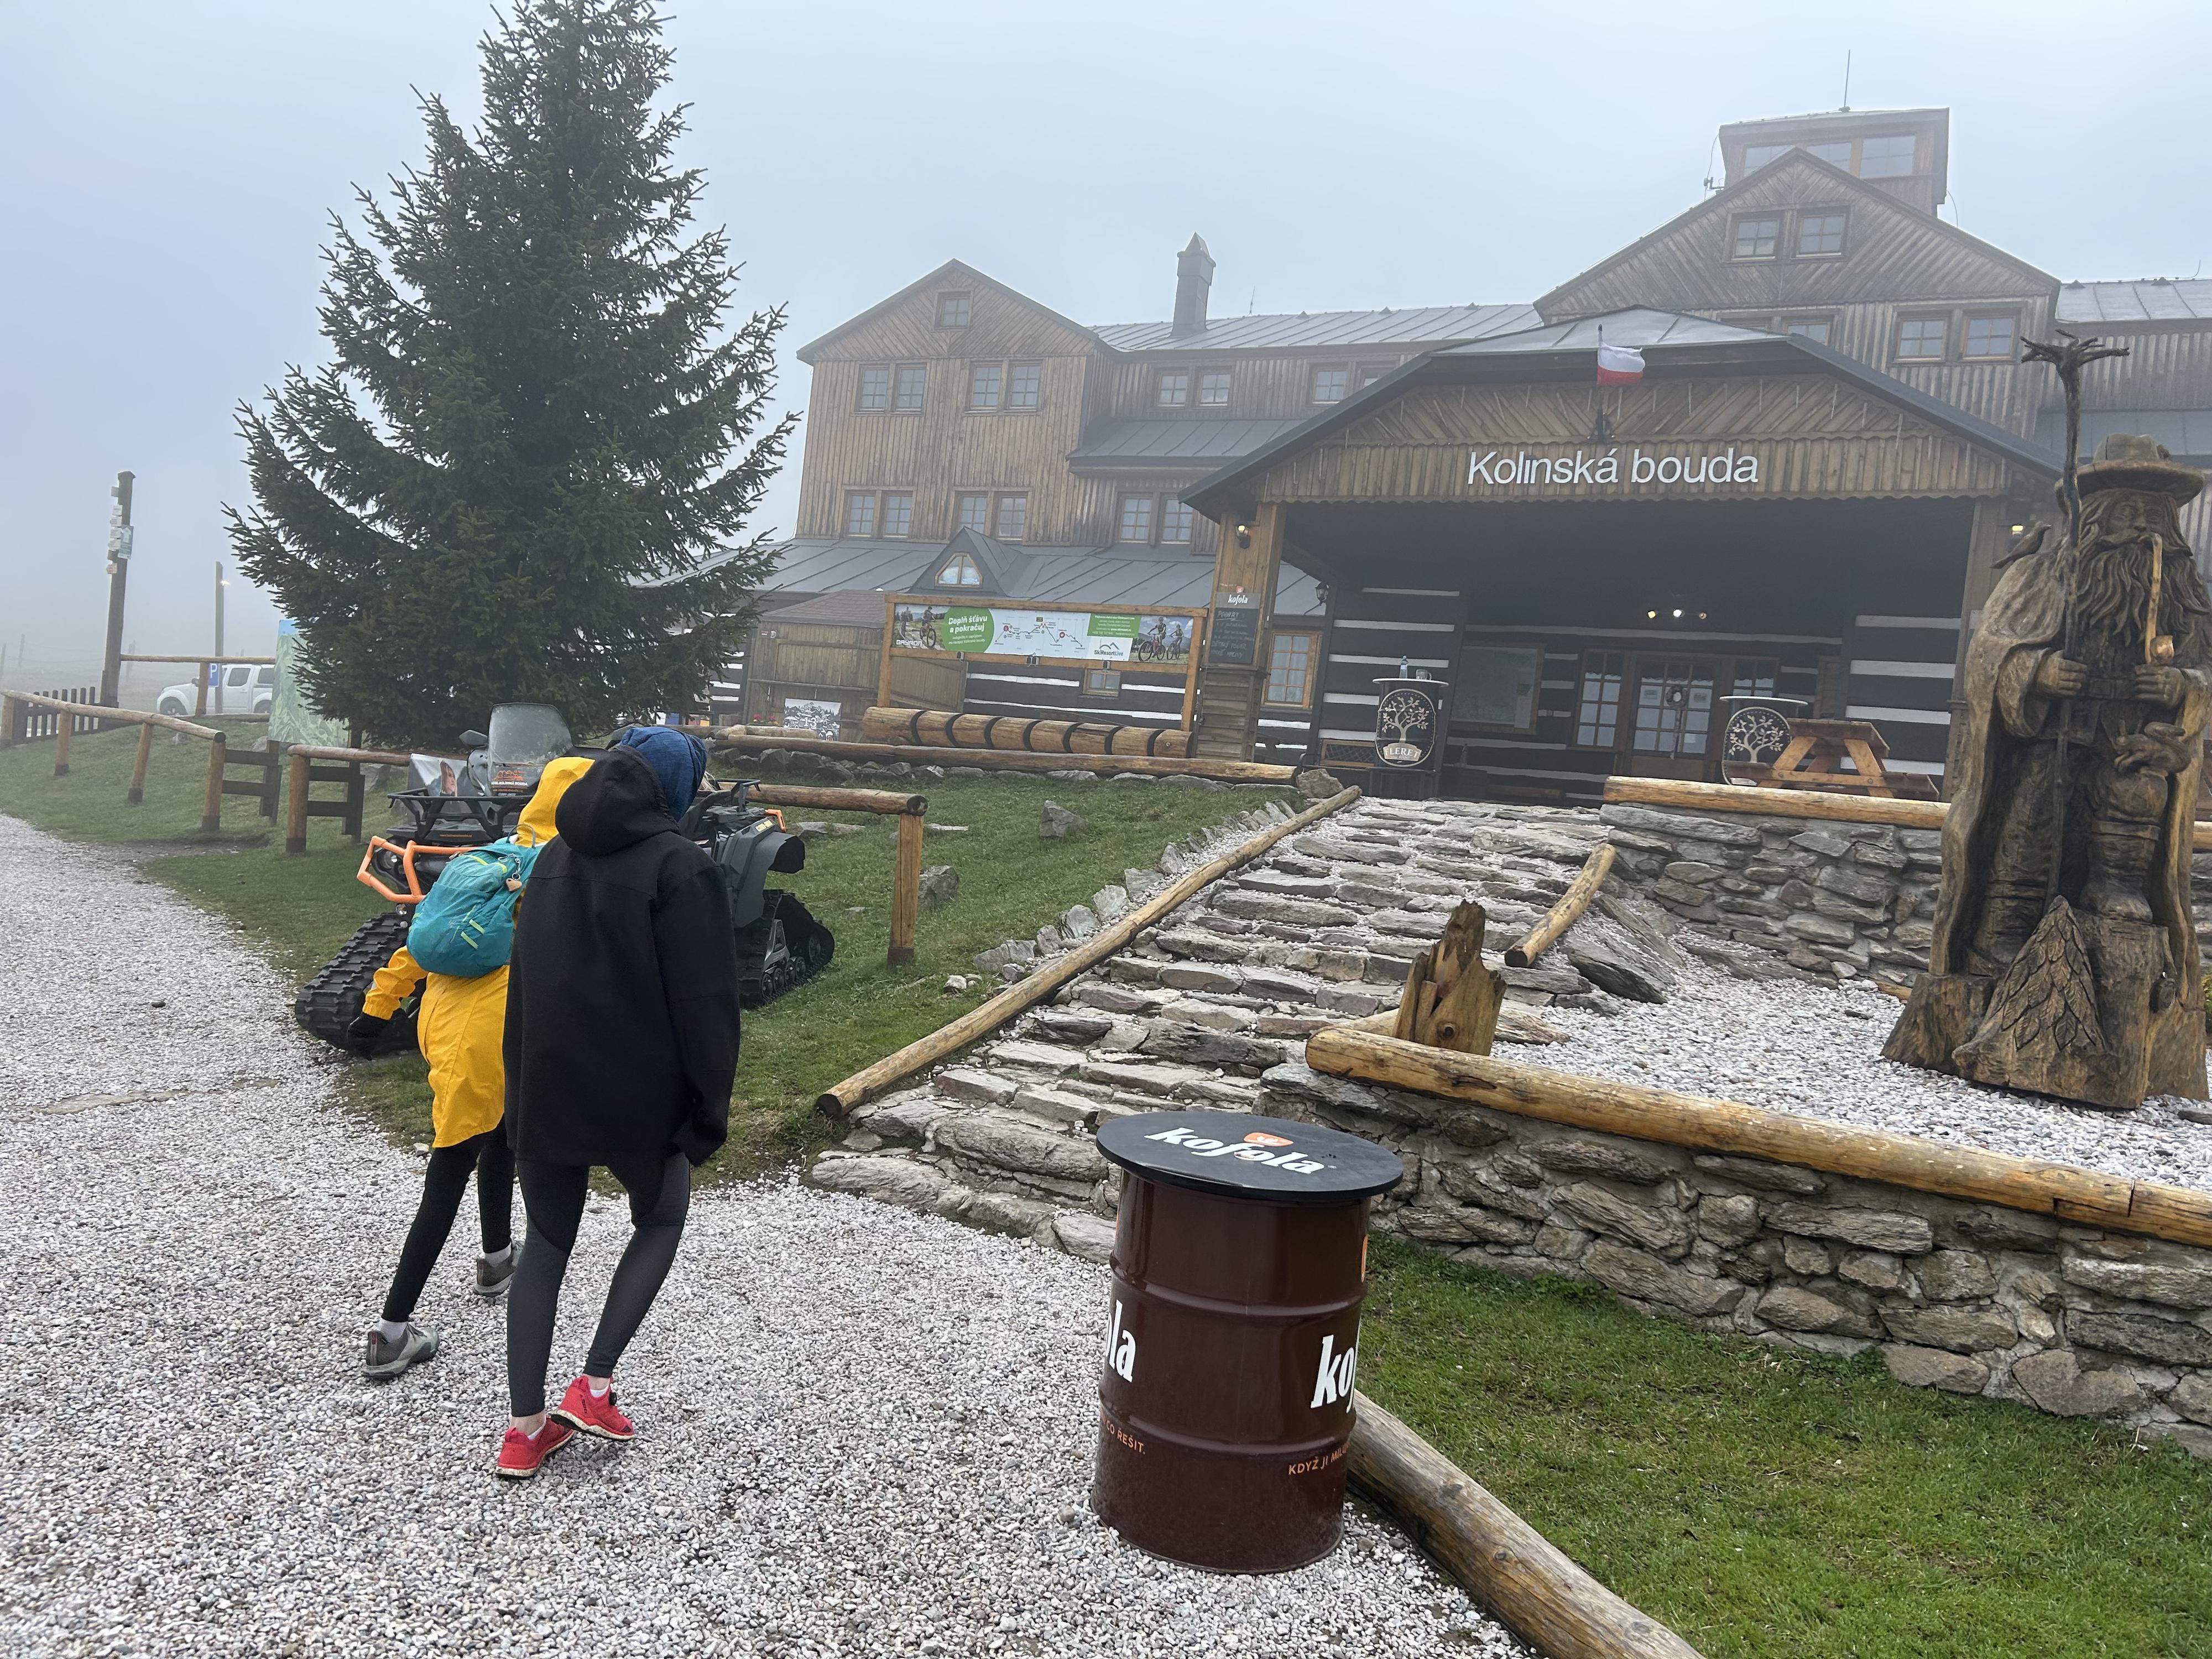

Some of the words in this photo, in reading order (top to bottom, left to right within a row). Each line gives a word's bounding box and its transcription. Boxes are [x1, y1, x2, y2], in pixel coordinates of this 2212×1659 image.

[1631, 447, 1759, 484] bouda
[1228, 594, 1248, 606] kofola
[948, 615, 967, 626] Doplň
[968, 615, 988, 623] šťávu
[954, 623, 985, 634] pokračuj
[210, 663, 218, 679] P
[1385, 748, 1419, 758] FLERET
[1144, 1127, 1325, 1174] kofola
[1106, 1420, 1115, 1434] CO
[1117, 1427, 1146, 1455] ŘEŠIT.
[1288, 1456, 1319, 1475] KDYŽ
[1320, 1455, 1328, 1470] JI
